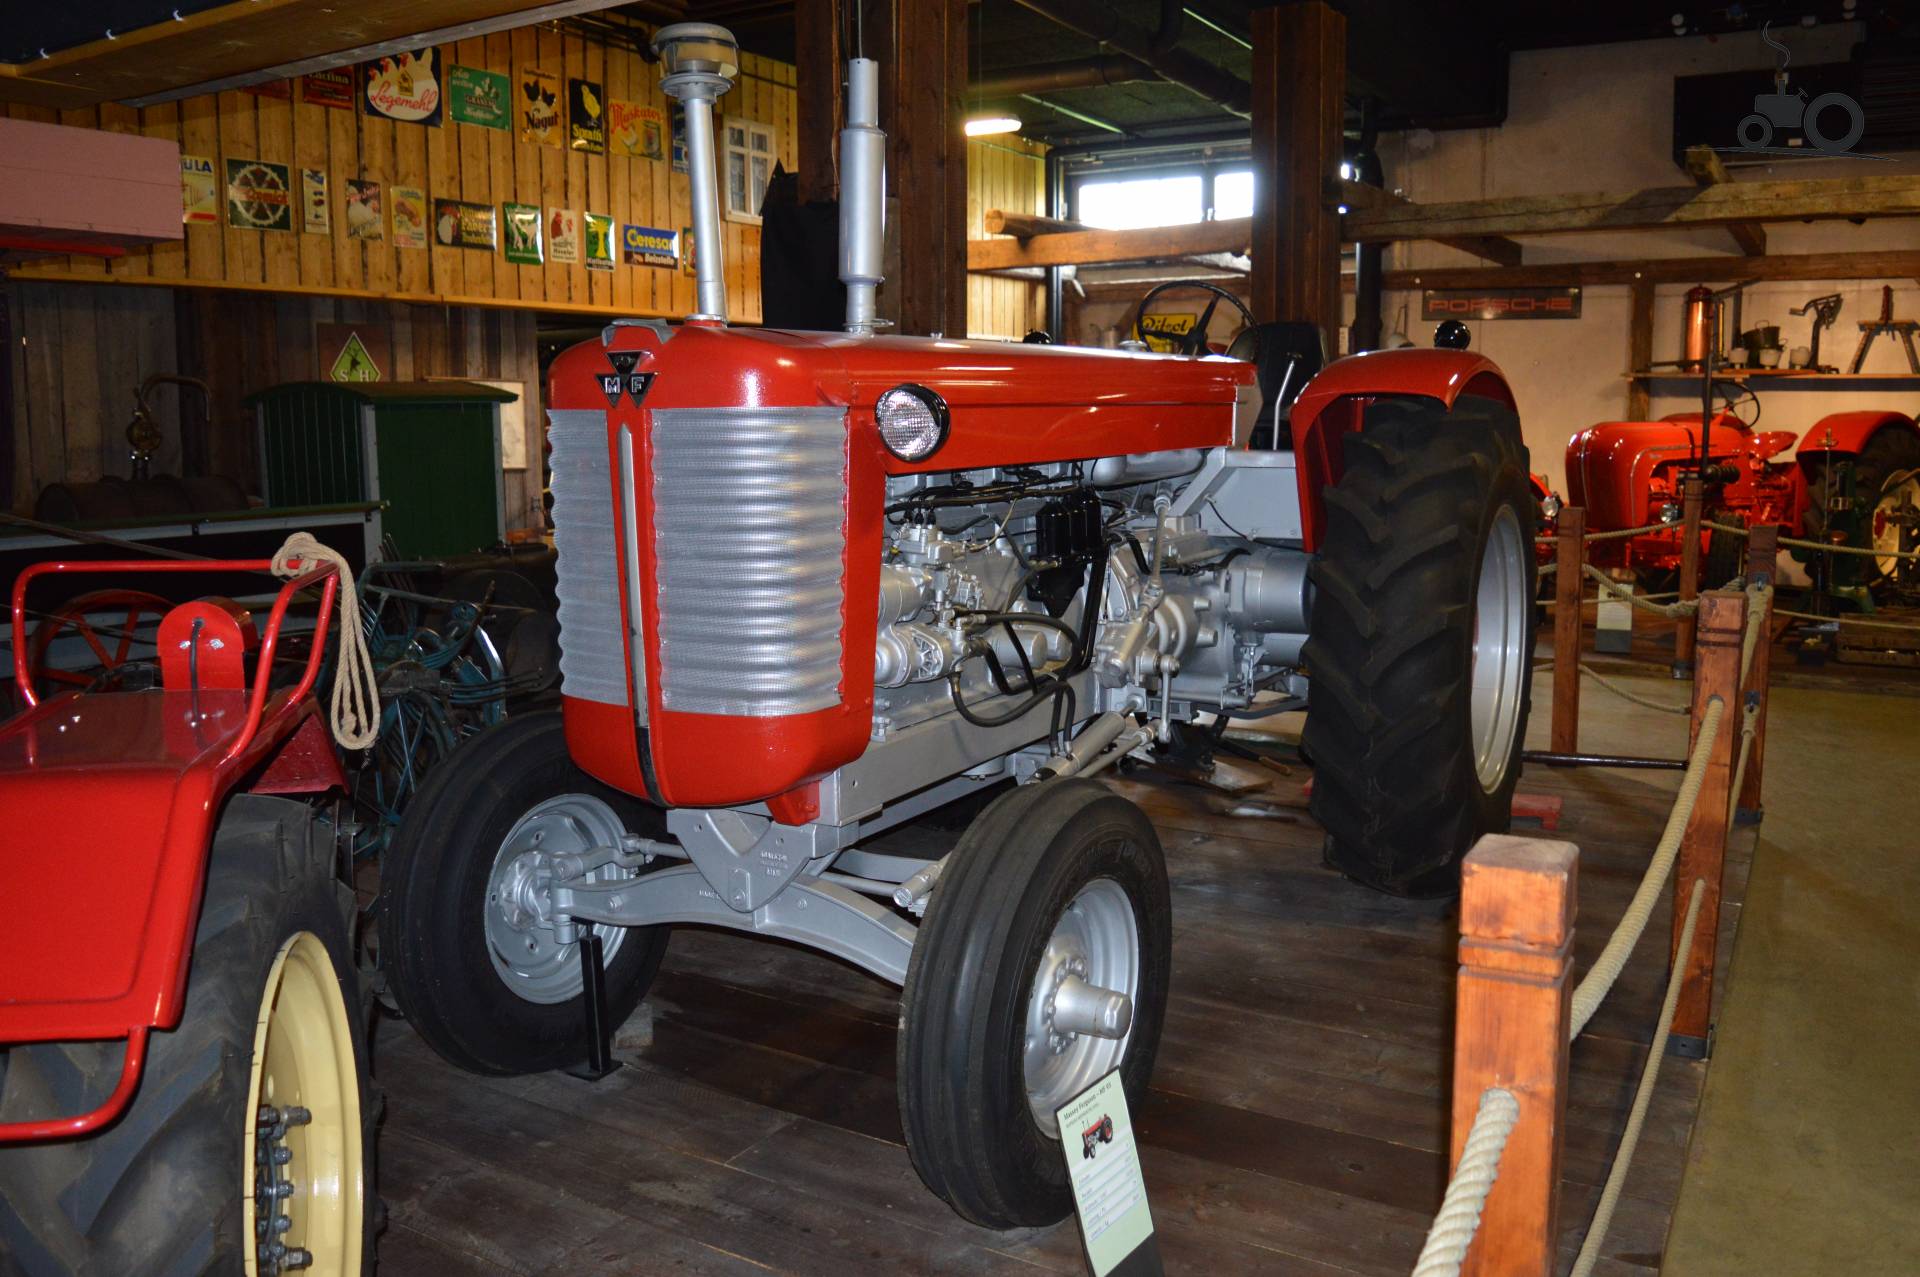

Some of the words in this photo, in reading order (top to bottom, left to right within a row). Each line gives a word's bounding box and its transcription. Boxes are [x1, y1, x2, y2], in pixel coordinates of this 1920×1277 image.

[371, 80, 437, 113] Legemehl
[525, 111, 559, 132] Nagut
[1429, 297, 1572, 312] PORSCHE
[340, 369, 348, 382] S
[360, 369, 369, 382] H
